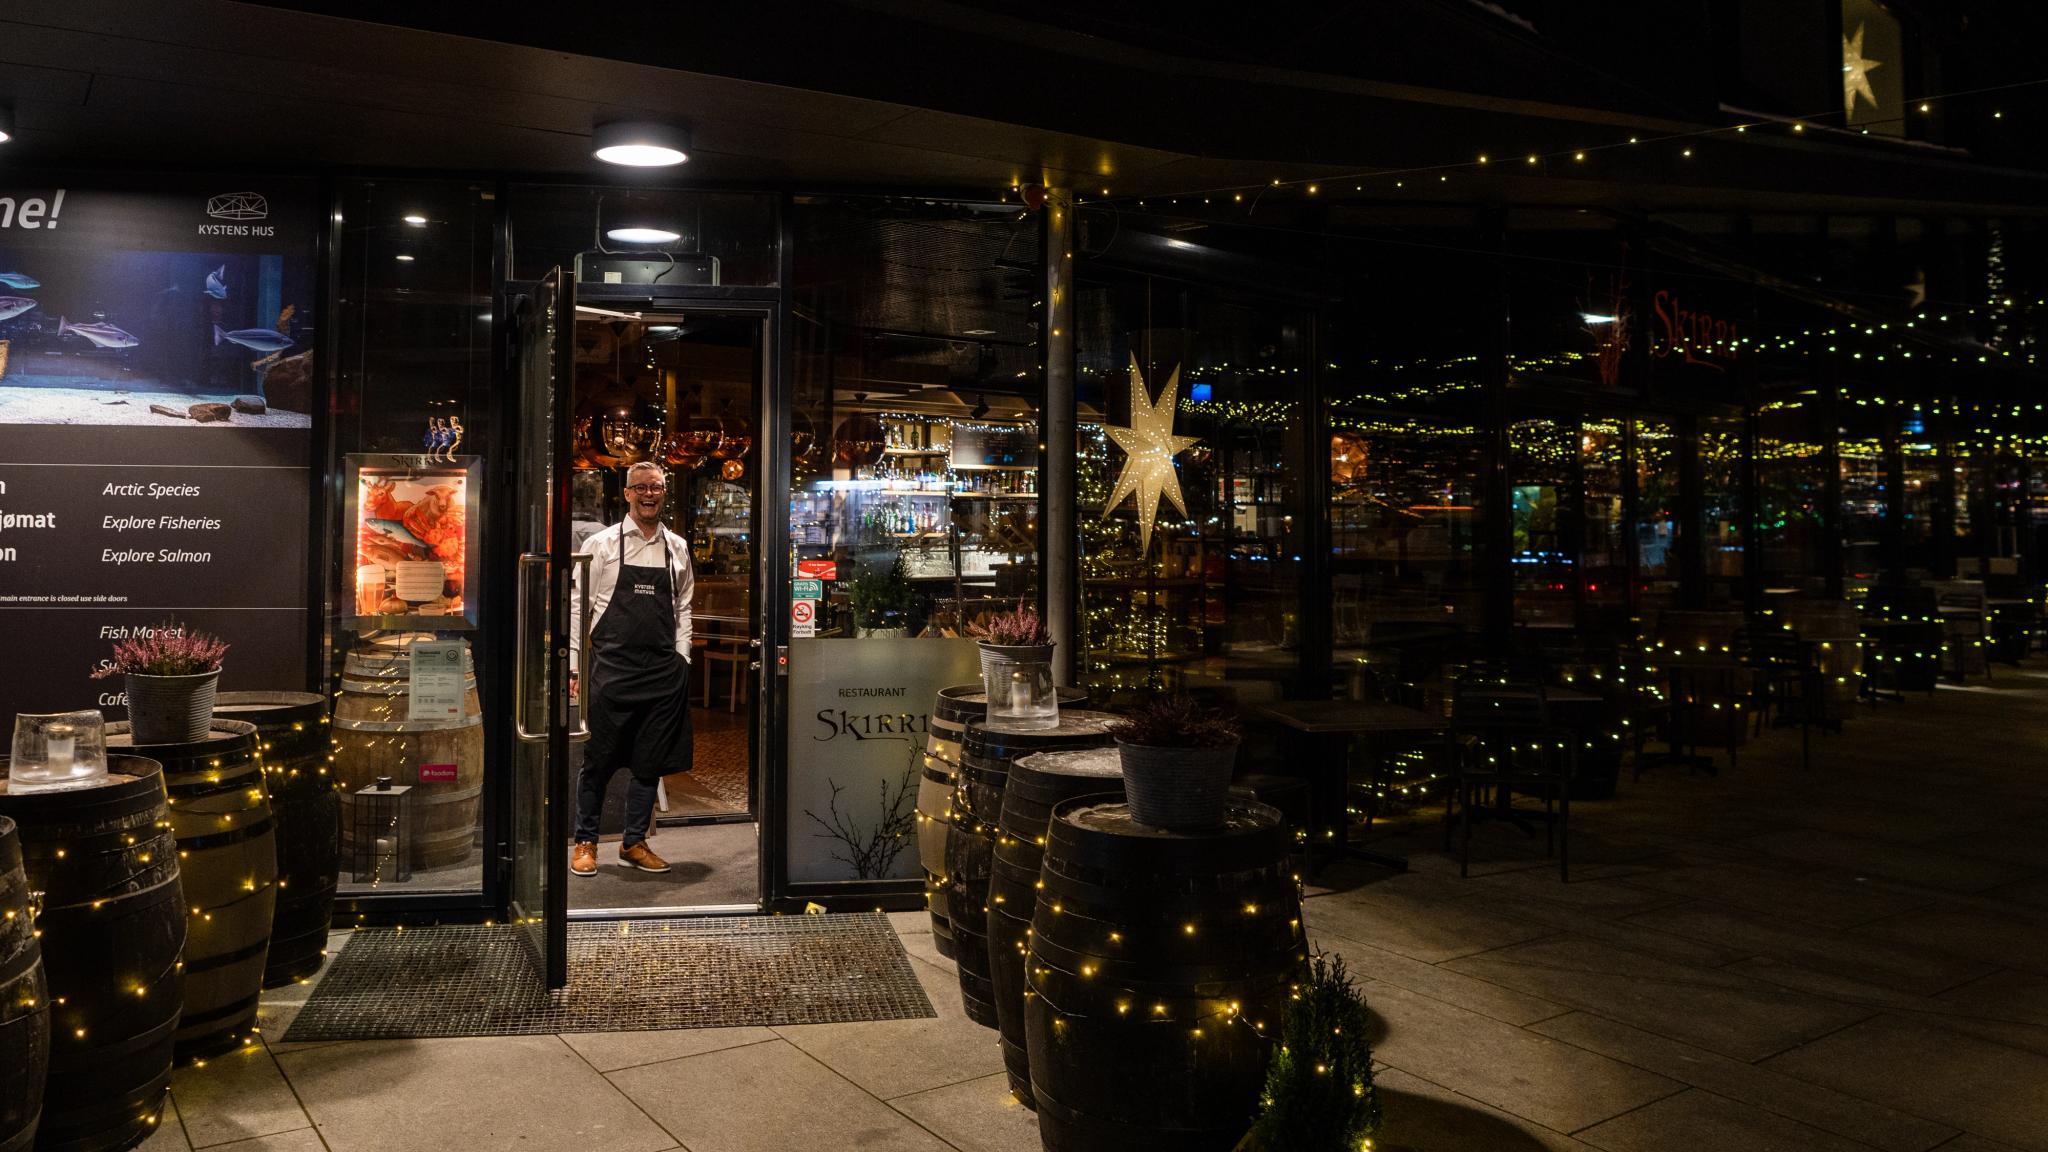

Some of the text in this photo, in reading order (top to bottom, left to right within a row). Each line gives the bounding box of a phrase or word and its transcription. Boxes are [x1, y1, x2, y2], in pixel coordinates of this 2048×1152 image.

[199, 225, 274, 237] KYSTENS HUS
[103, 482, 200, 499] Arctic Species
[103, 516, 221, 532] Explore Fisheries
[102, 549, 211, 565] Explore Salmon
[100, 625, 129, 639] Fish
[838, 688, 906, 697] RESTAURANT
